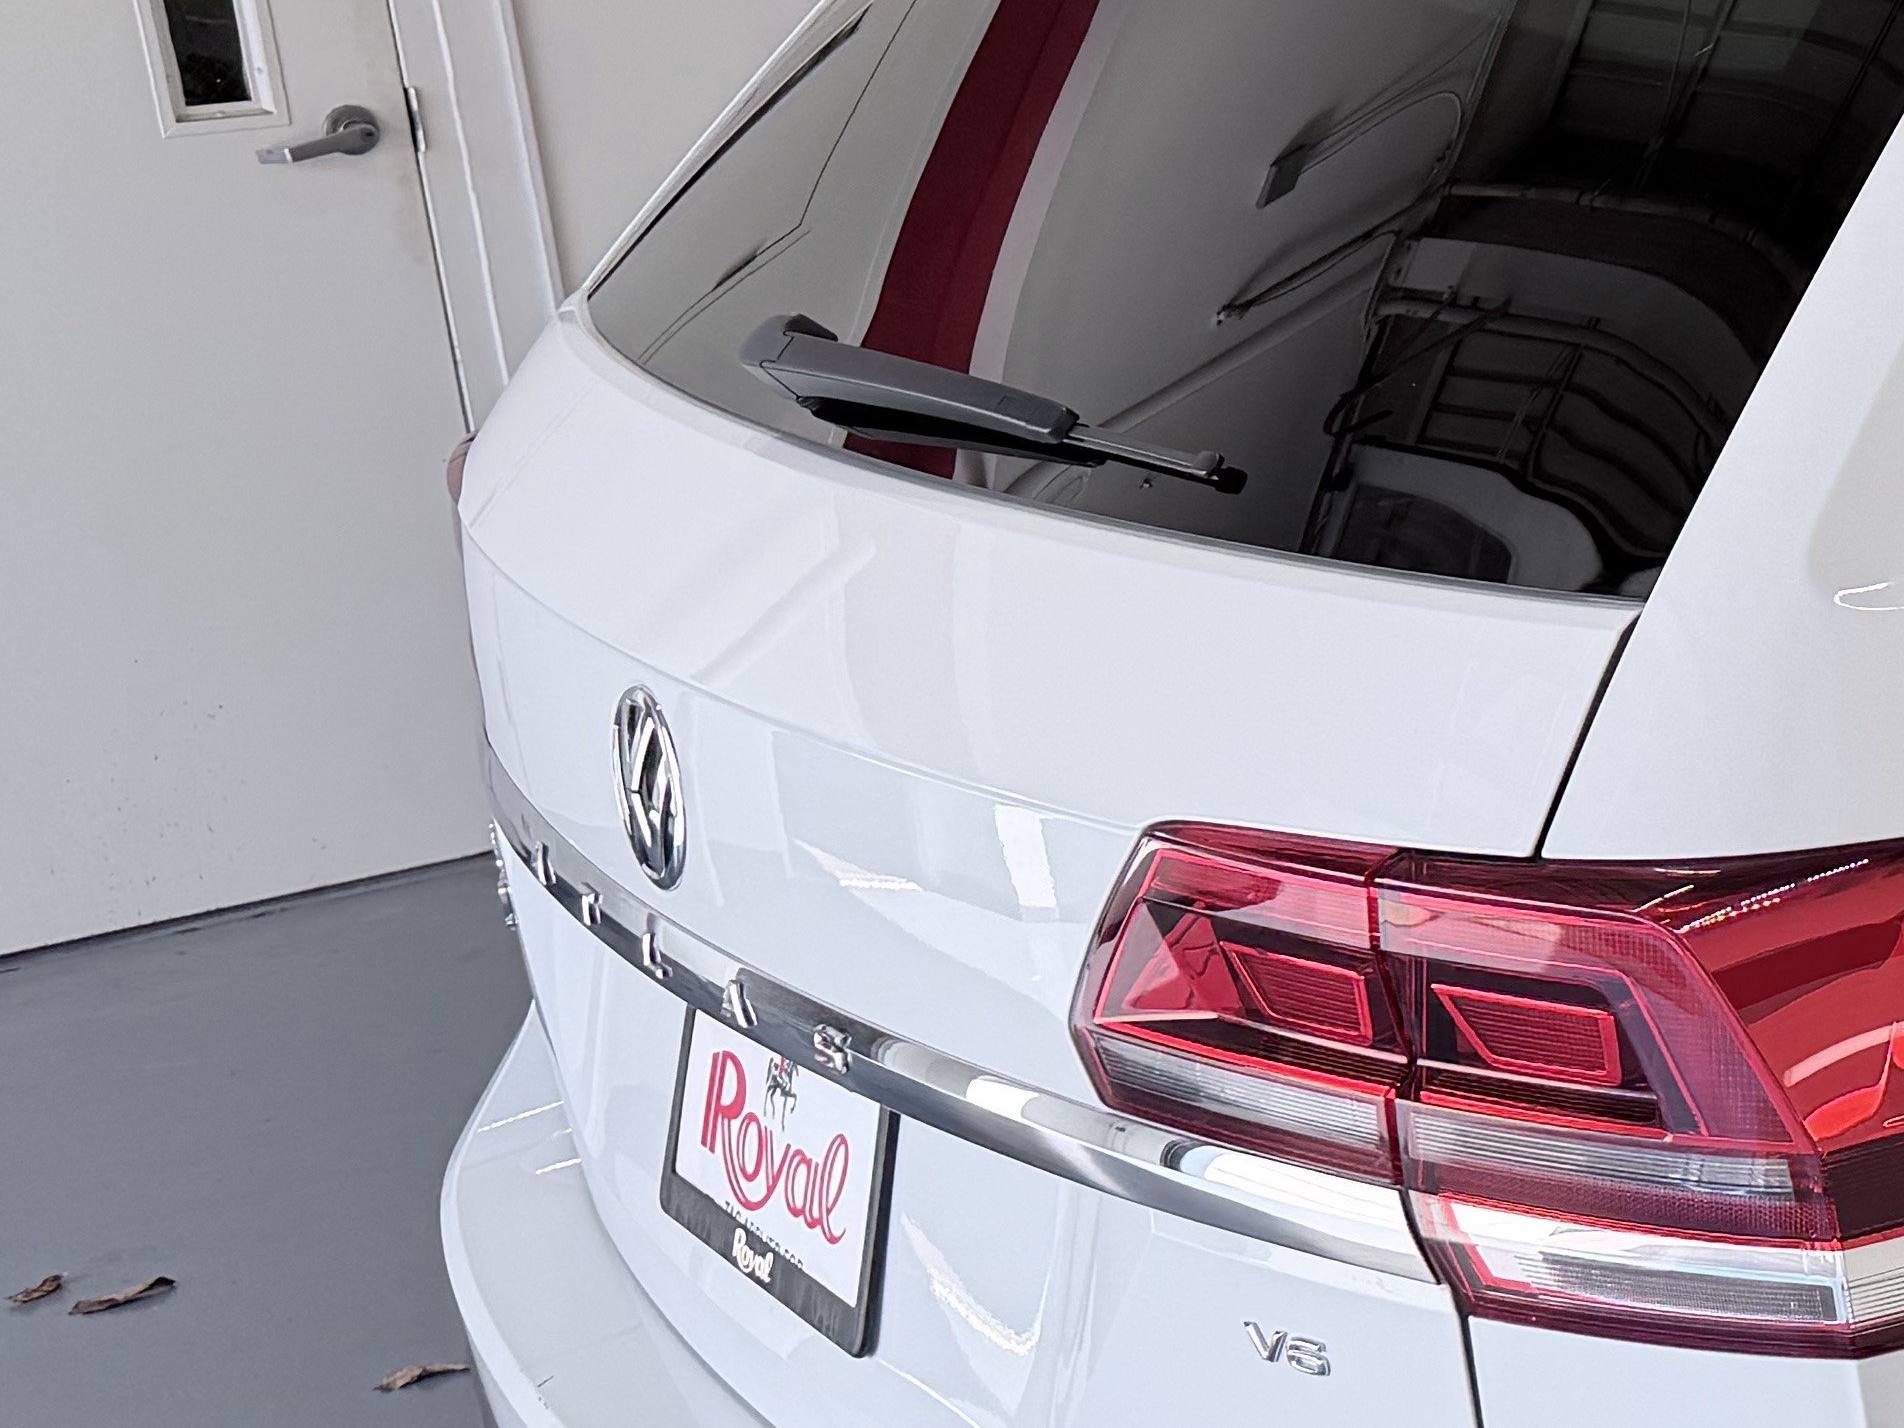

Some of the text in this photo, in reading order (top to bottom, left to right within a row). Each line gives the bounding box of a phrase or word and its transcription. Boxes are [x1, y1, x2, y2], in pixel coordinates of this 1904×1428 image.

[700, 1049, 859, 1246] Royal
[731, 1227, 775, 1284] Royal
[1242, 1320, 1332, 1377] V6
